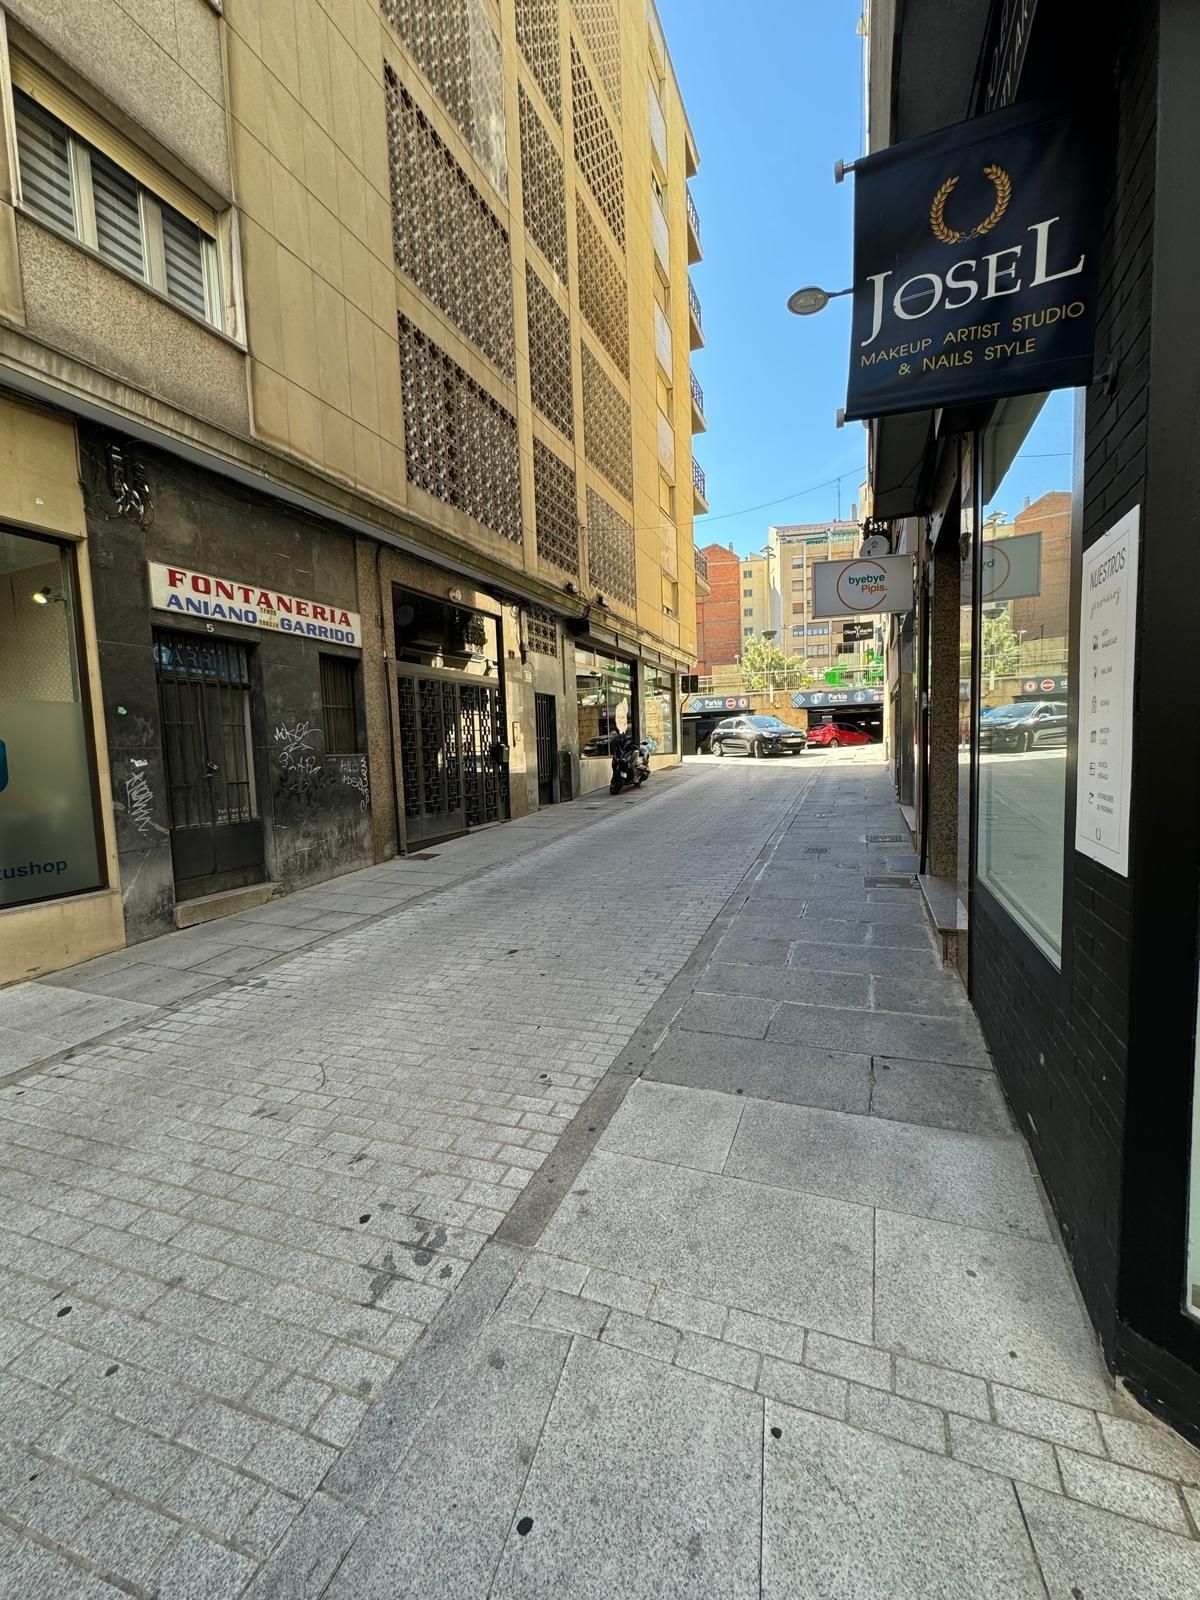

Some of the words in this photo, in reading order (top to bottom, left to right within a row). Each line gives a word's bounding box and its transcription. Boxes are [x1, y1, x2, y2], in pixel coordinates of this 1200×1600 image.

[861, 216, 1085, 347] JOSEL
[861, 338, 932, 367] MAKEUP
[943, 322, 1001, 345] ARTIST
[1012, 302, 1085, 332] STUDIO
[898, 363, 911, 375] &
[922, 350, 973, 371] NAILS
[984, 338, 1036, 360] STYLE
[848, 574, 885, 587] byebye
[1089, 547, 1126, 591] NUESTROS
[166, 594, 258, 625] ANIANO
[167, 568, 352, 627] FONTANERIA
[206, 623, 215, 633] 5
[280, 618, 355, 644] GARRIDO
